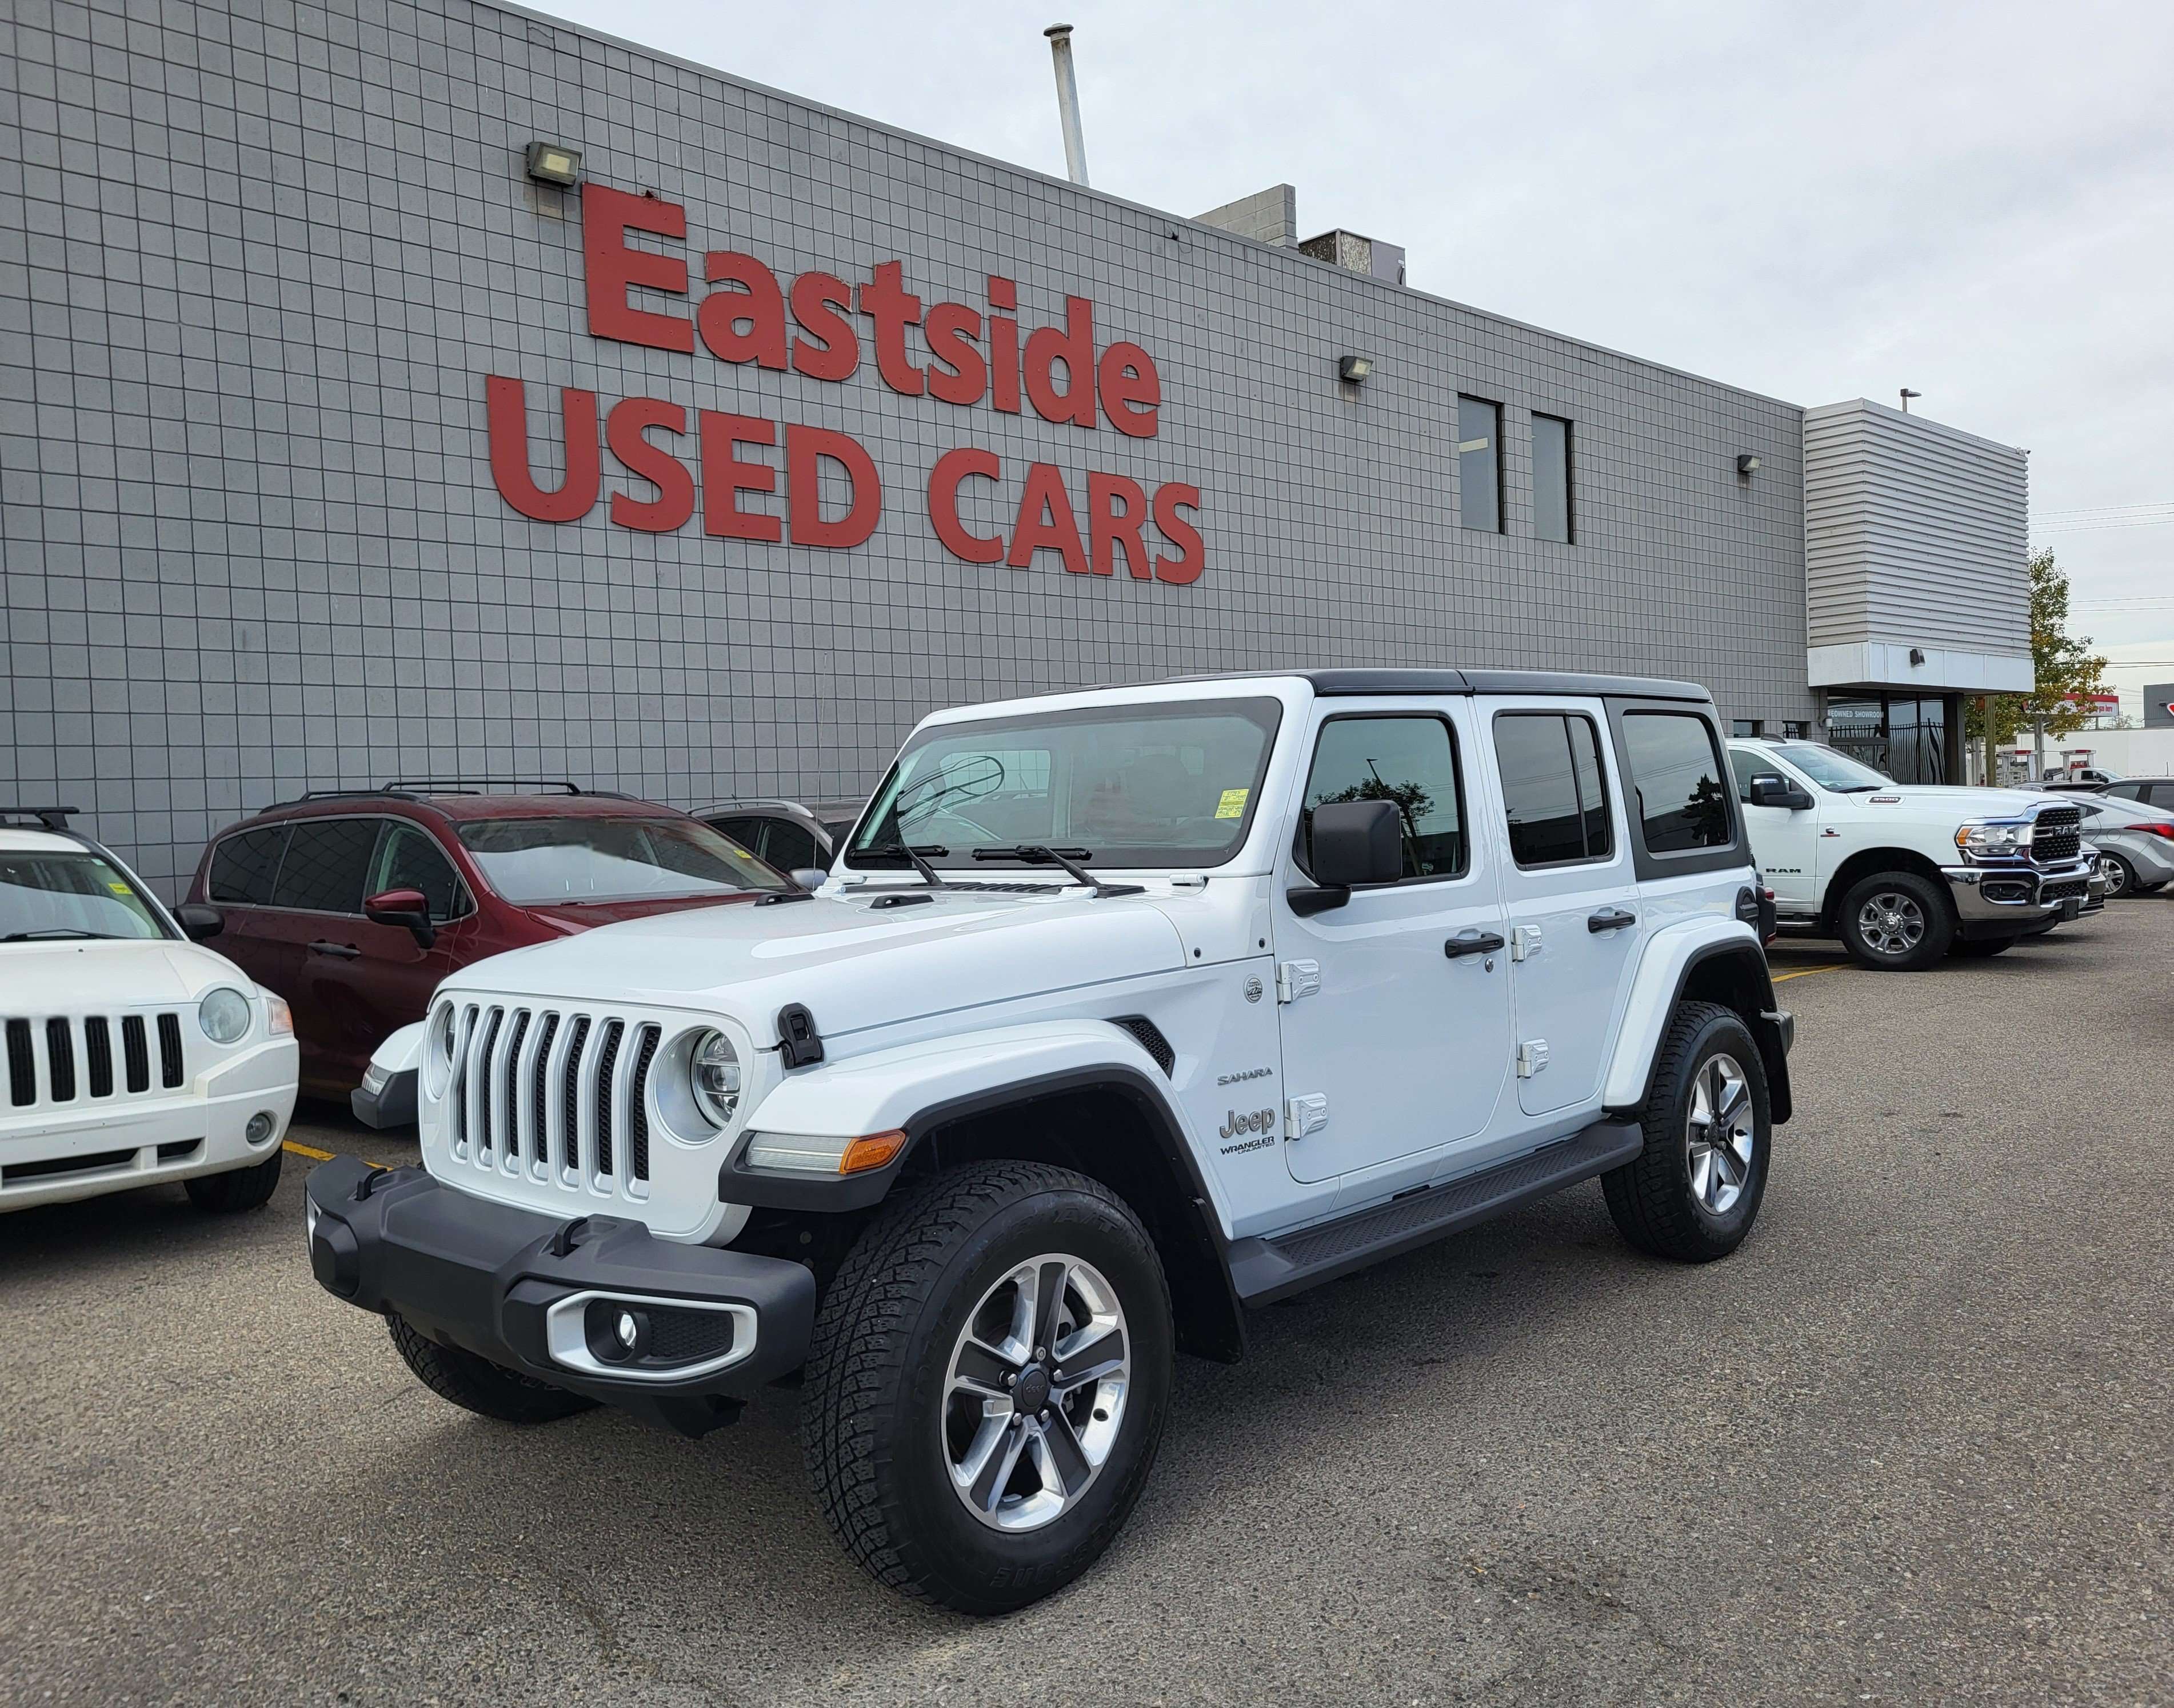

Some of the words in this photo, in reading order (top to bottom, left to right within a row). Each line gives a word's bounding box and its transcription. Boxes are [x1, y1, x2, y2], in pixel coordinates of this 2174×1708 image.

[582, 182, 1160, 437] Eastside
[486, 375, 882, 548] USED
[929, 447, 1205, 584] CARS
[1217, 1066, 1273, 1086] SAHARA
[1219, 1107, 1276, 1138] Jeep
[1220, 1136, 1274, 1155] WRANGLER
[1238, 1142, 1275, 1154] UNLIMITED
